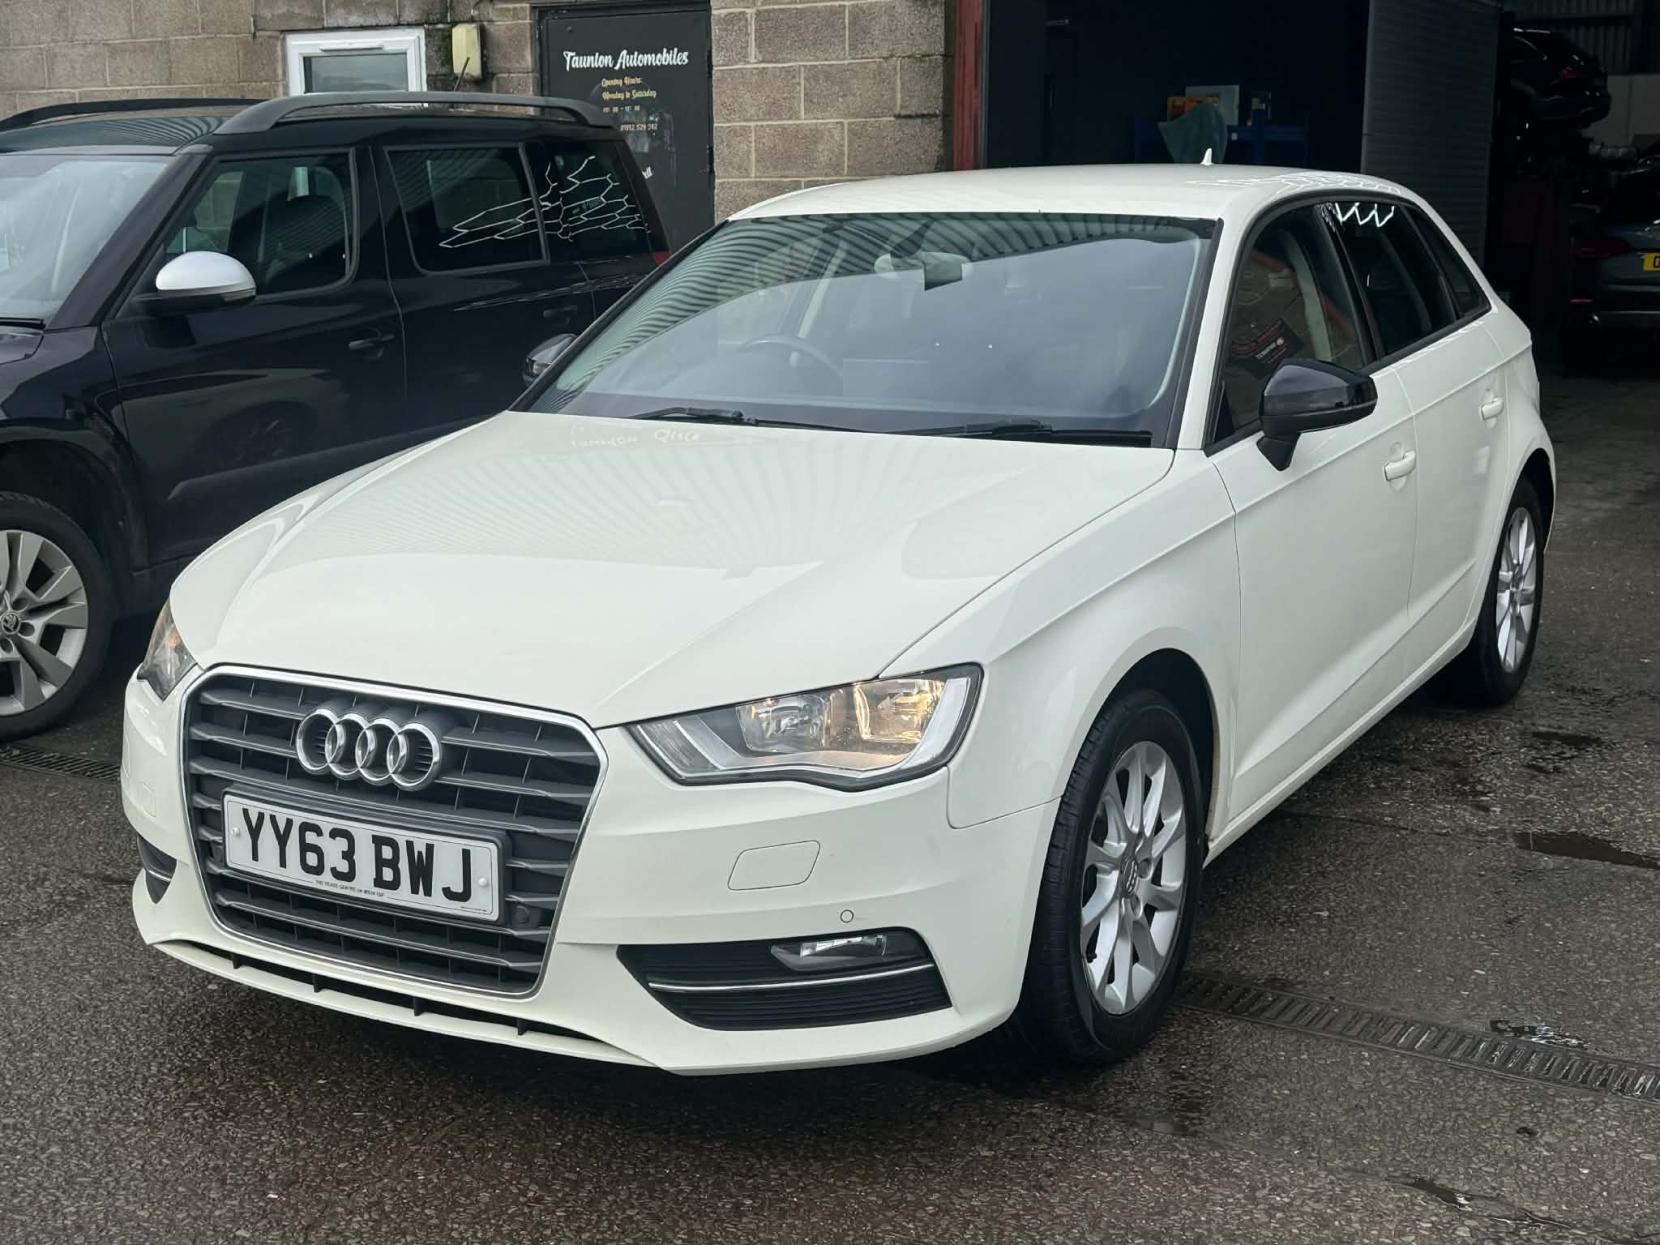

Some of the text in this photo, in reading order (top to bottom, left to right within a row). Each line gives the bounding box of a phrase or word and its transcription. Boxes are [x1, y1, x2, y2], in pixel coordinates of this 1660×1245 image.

[563, 47, 688, 71] Taunton Automobiles
[632, 89, 656, 99] Saturday
[242, 808, 472, 903] YY63 BWJ
